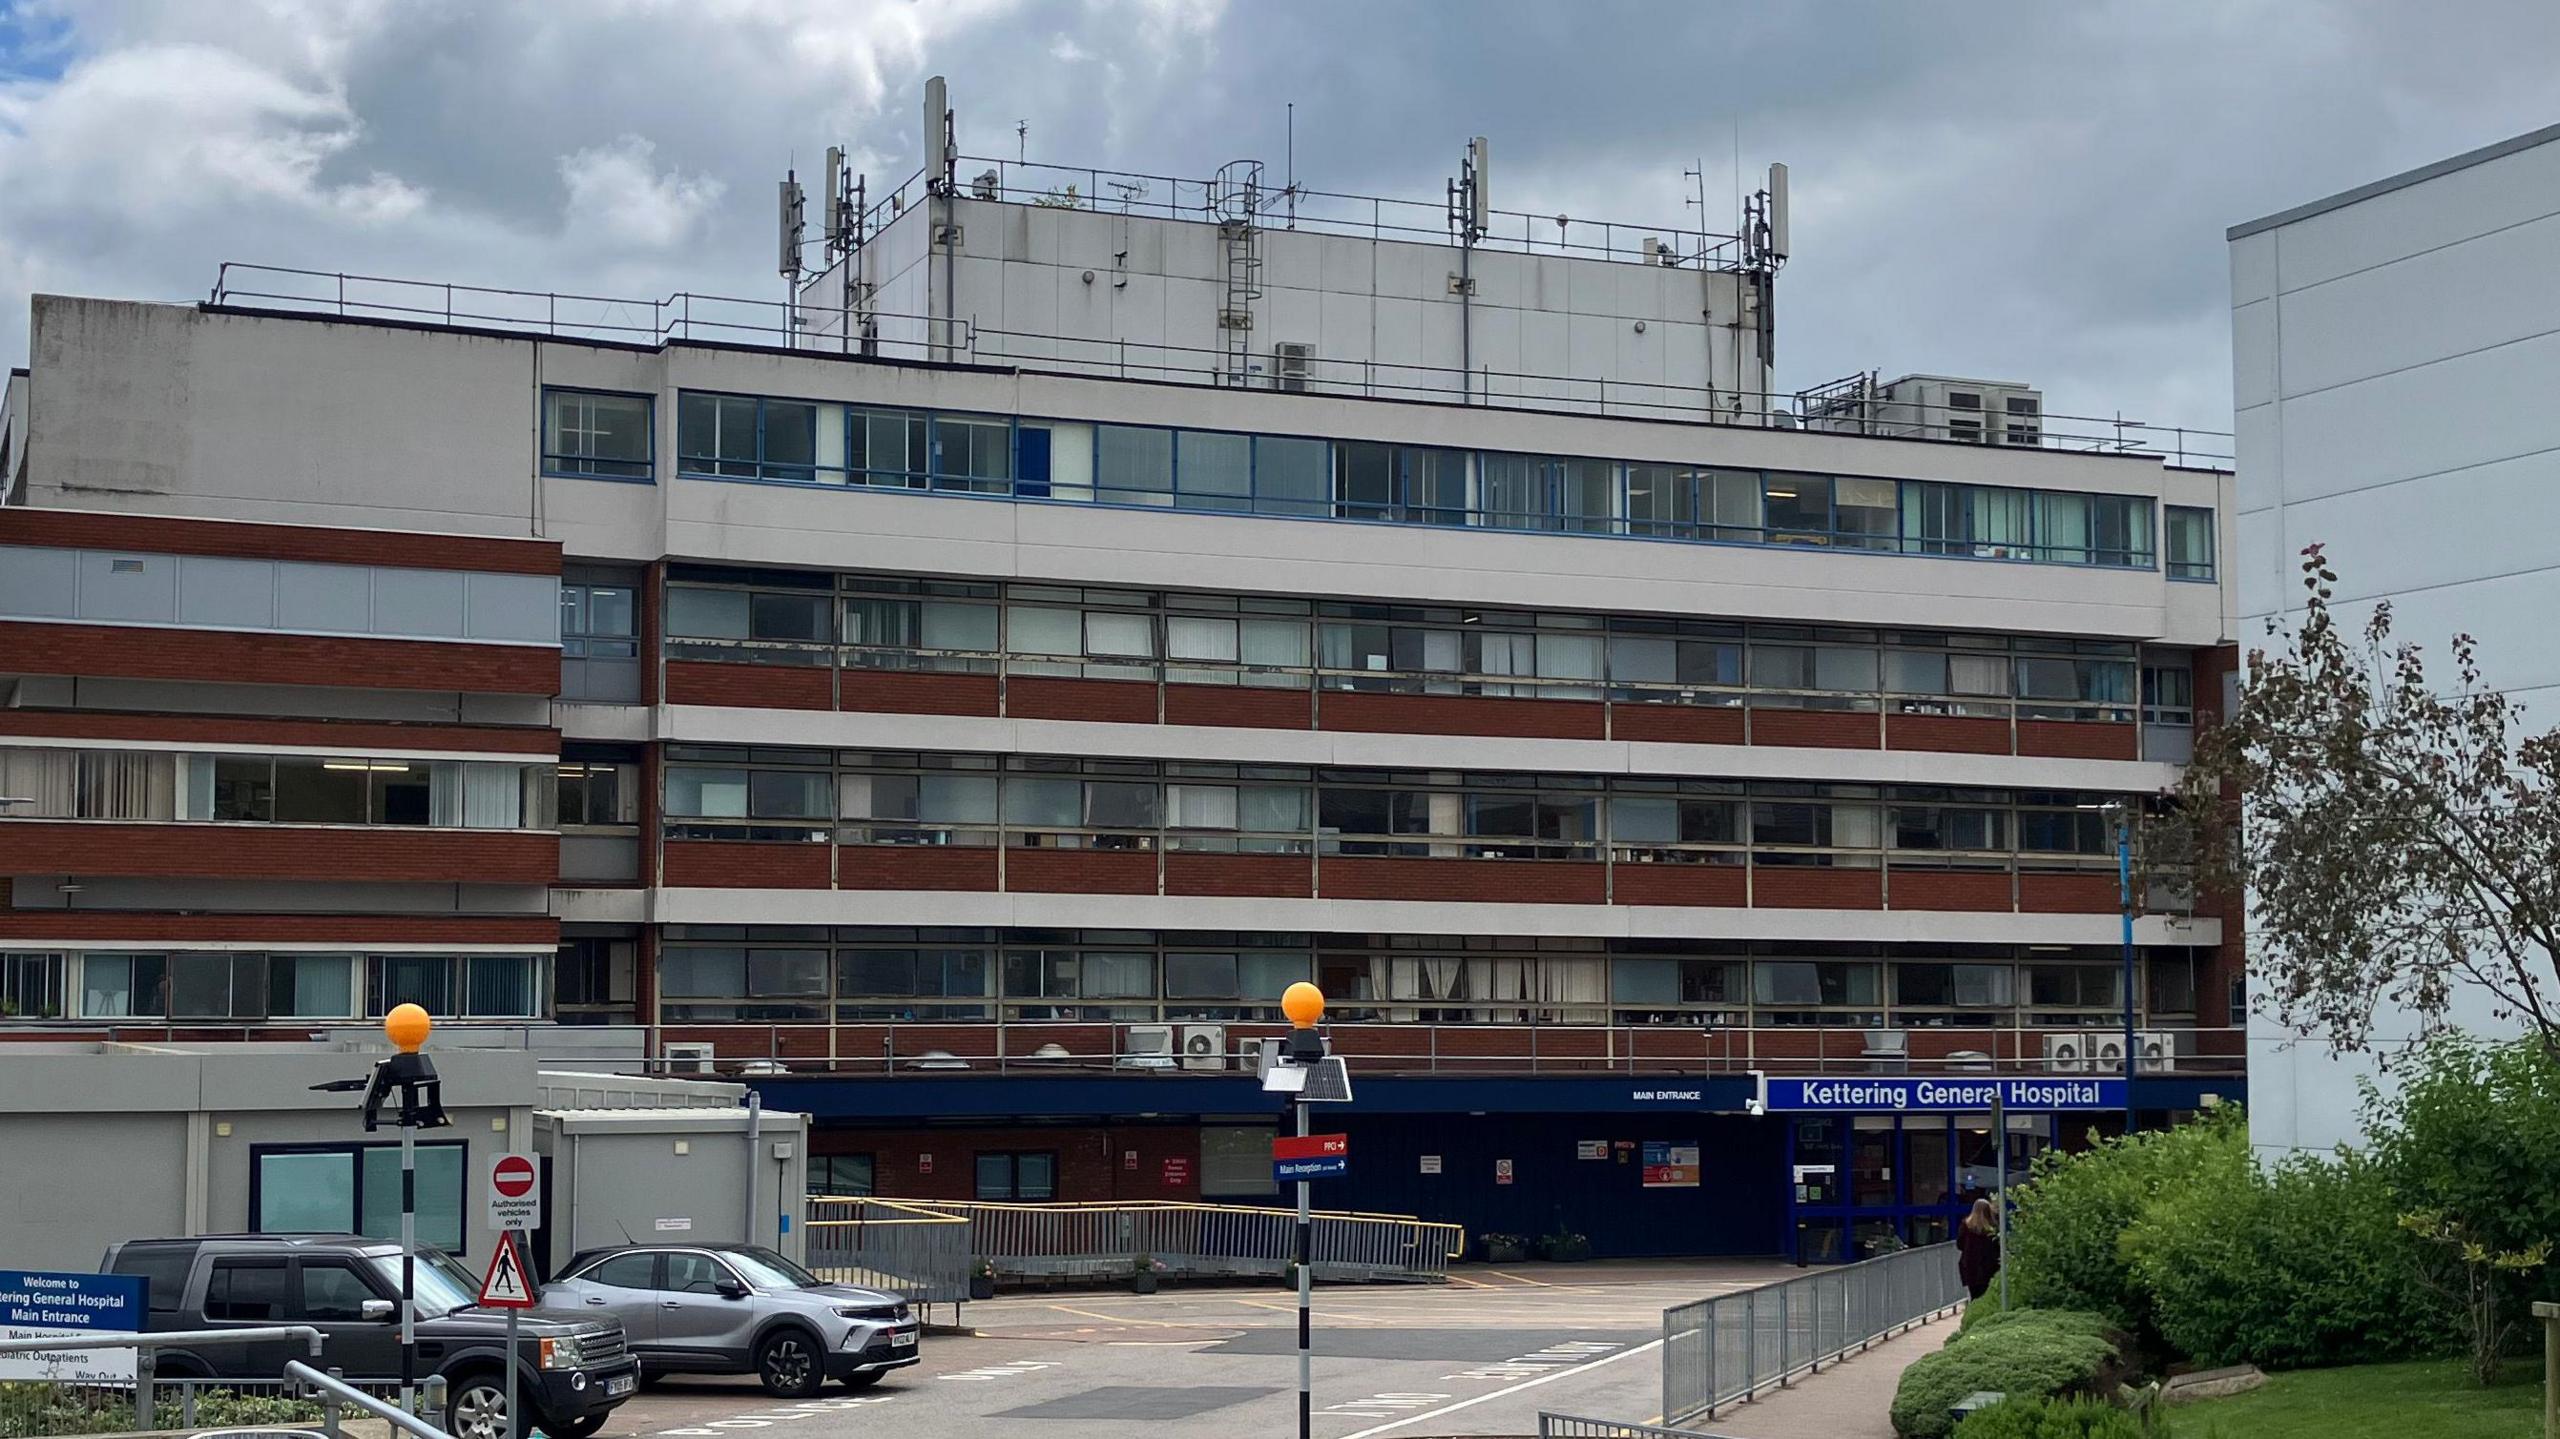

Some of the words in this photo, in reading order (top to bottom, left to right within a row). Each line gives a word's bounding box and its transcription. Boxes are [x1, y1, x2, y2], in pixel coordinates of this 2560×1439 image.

[1633, 1091, 1654, 1100] MAIN
[1656, 1091, 1701, 1100] ENTRANCE
[1802, 1082, 1907, 1108] Kettering
[1916, 1081, 2001, 1104] General
[2011, 1082, 2099, 1108] Hospital
[1280, 1164, 1295, 1174] Main
[1295, 1162, 1322, 1175] Reception
[492, 1200, 537, 1208] Authorised
[497, 1209, 531, 1217] vehicles
[505, 1218, 523, 1227] only
[23, 1276, 67, 1289] Welcome
[69, 1279, 80, 1290] to
[33, 1292, 75, 1306] General
[78, 1294, 124, 1309] Hospital
[11, 1309, 39, 1322] Main
[42, 1310, 90, 1323] Entrance
[9, 1330, 33, 1340] Main
[33, 1350, 88, 1364] Outpatients
[657, 1396, 896, 1436] POLICE
[936, 1360, 1063, 1381] ONLY
